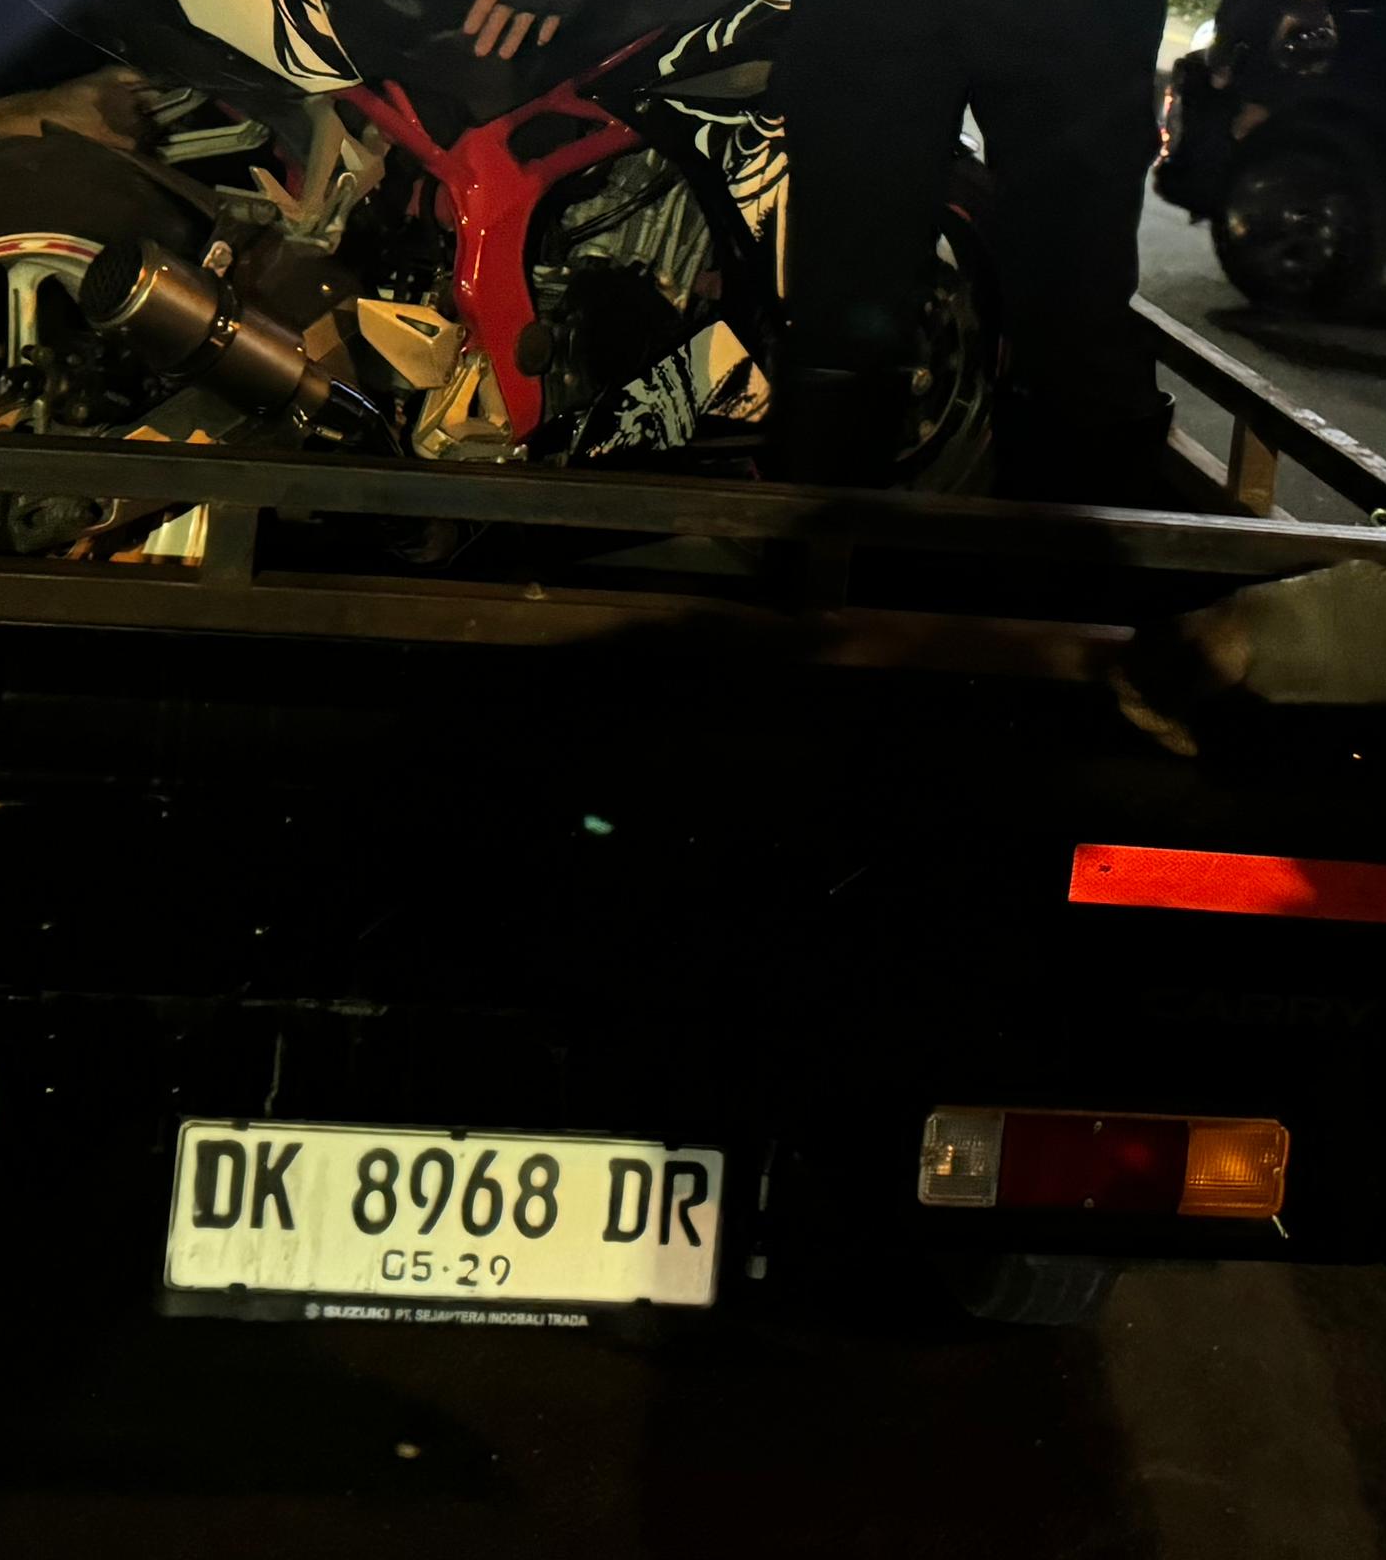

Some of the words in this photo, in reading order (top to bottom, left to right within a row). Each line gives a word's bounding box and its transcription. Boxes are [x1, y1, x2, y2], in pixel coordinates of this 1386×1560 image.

[192, 1139, 304, 1231] DK
[351, 1146, 560, 1241] 8968
[601, 1156, 710, 1247] DR
[323, 1305, 391, 1320] SUZUKI
